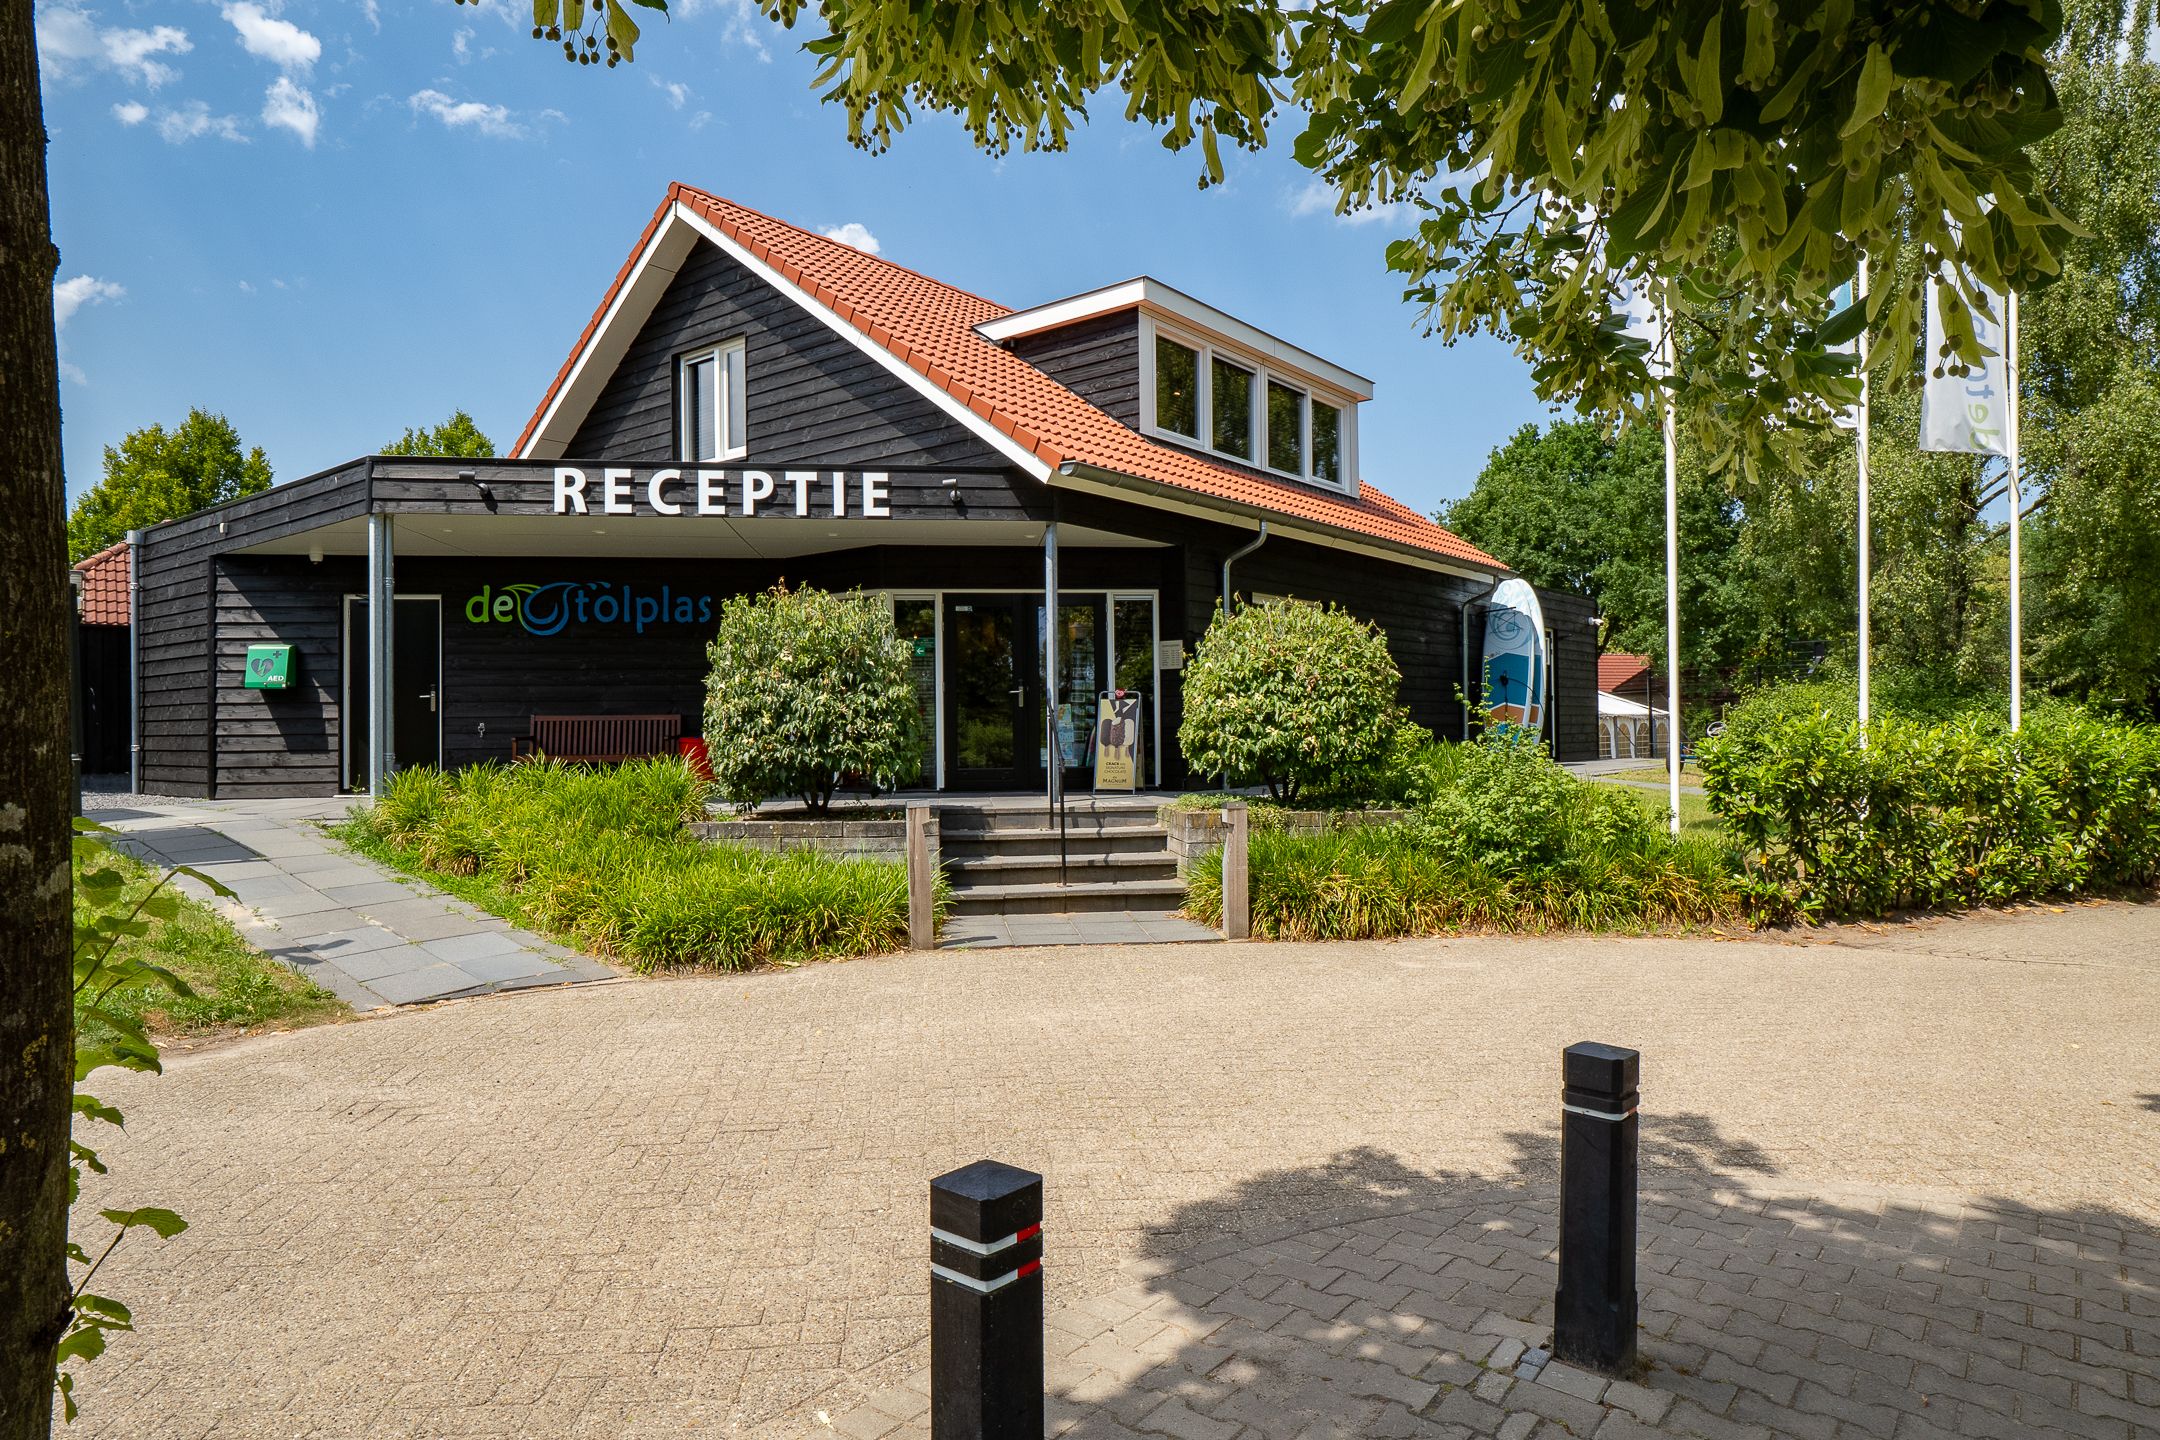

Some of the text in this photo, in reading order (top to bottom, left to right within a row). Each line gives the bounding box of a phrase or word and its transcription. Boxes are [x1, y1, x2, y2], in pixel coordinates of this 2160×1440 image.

[553, 467, 890, 517] RECEPTIE
[465, 584, 712, 634] de tolplas
